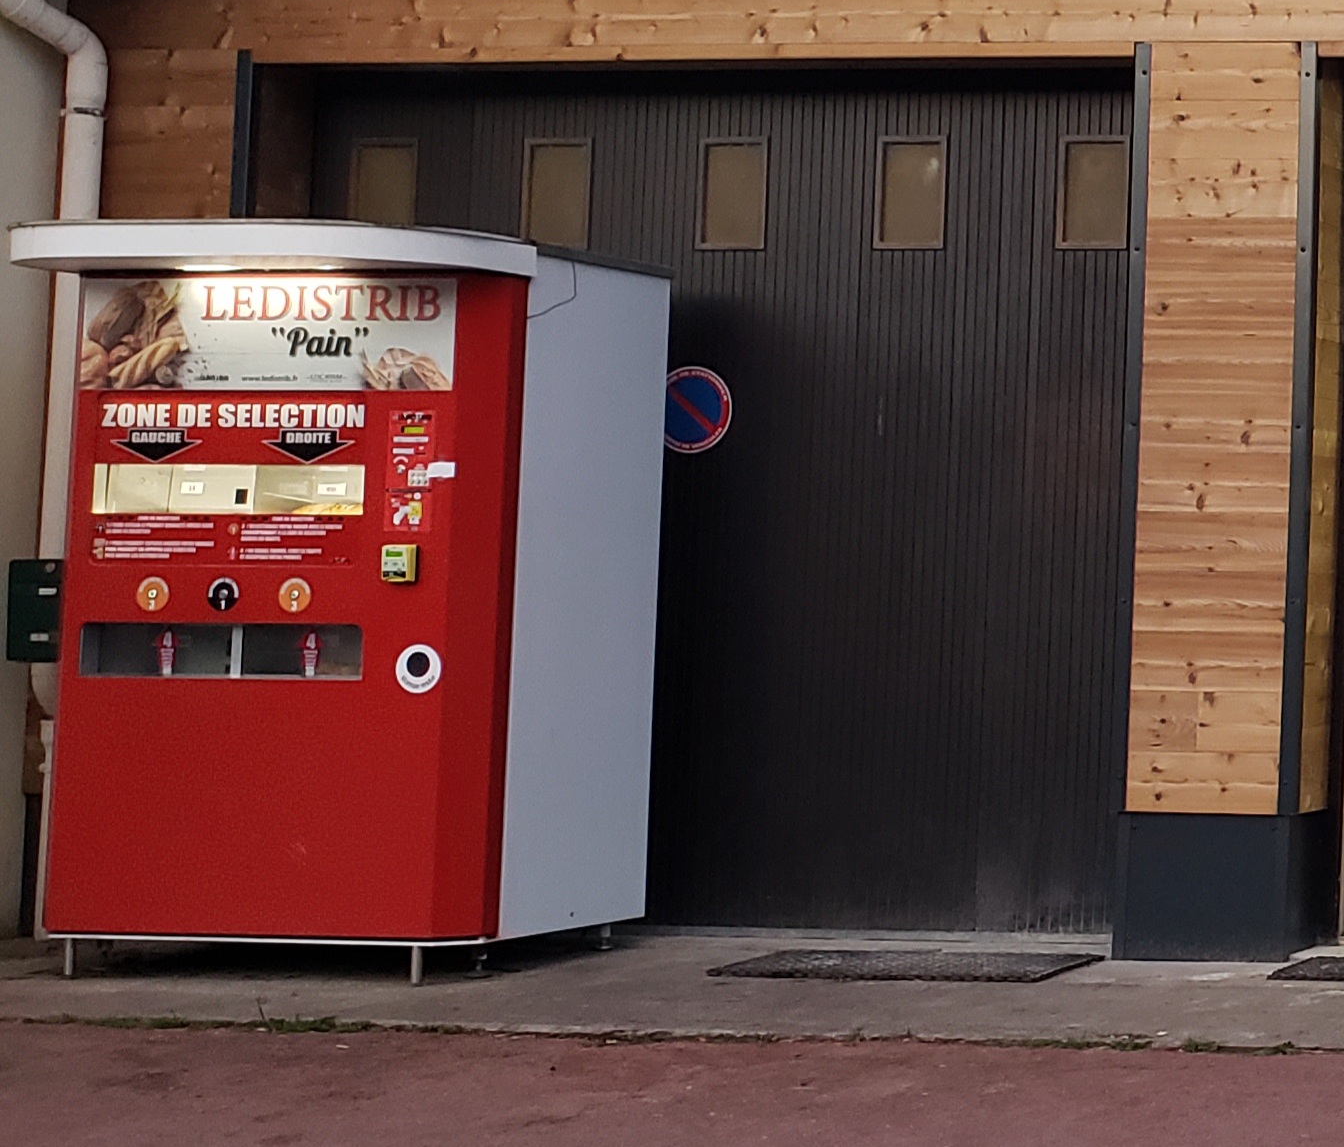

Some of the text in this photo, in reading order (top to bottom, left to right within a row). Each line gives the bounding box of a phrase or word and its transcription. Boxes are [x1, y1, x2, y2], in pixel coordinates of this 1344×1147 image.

[200, 284, 443, 322] LEDISTRIB
[101, 404, 170, 427] ZONE
[177, 404, 212, 428] DE
[217, 404, 366, 429] SELECTION
[131, 432, 182, 444] GAUCHE
[286, 431, 332, 444] DROITE
[220, 600, 226, 610] 1
[163, 631, 172, 648] 4
[306, 633, 316, 650] 4
